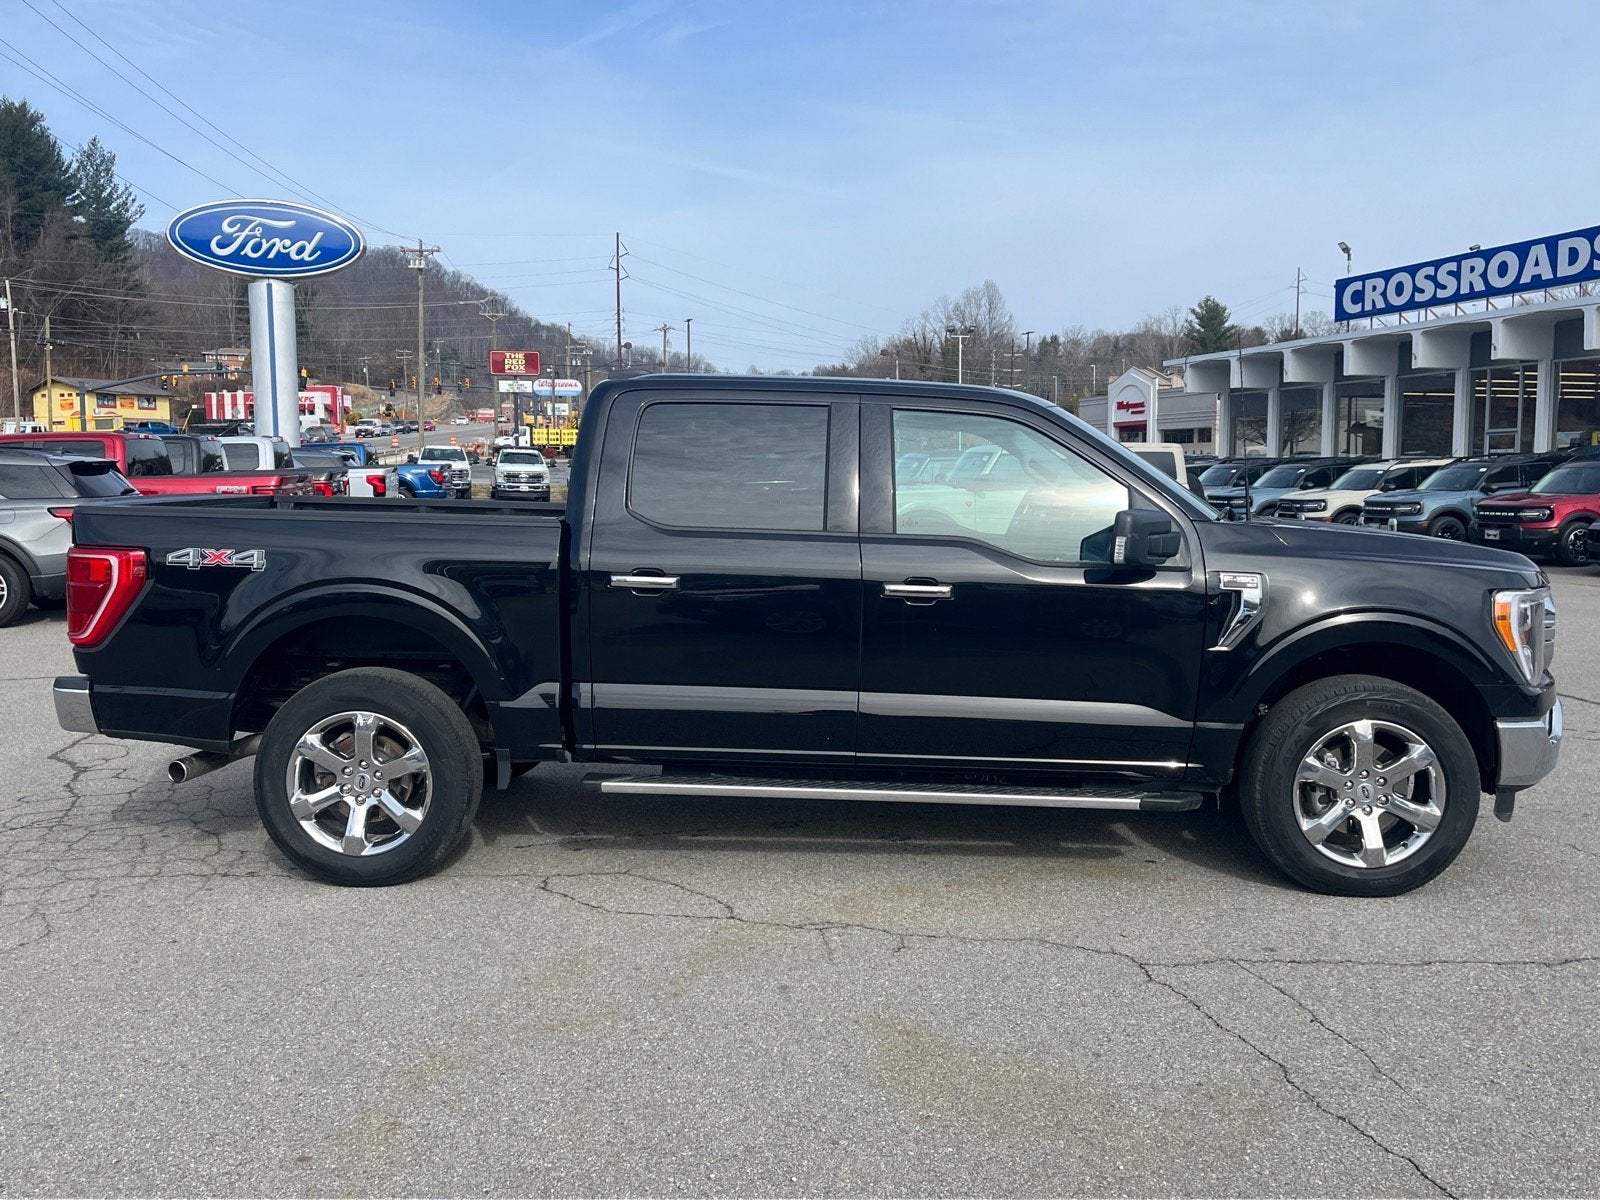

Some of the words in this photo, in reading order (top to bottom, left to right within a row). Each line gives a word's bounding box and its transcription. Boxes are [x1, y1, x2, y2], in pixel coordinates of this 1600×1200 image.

[210, 215, 324, 261] Ford
[1342, 235, 1600, 314] CROSSROAD
[538, 380, 578, 388] Wareens
